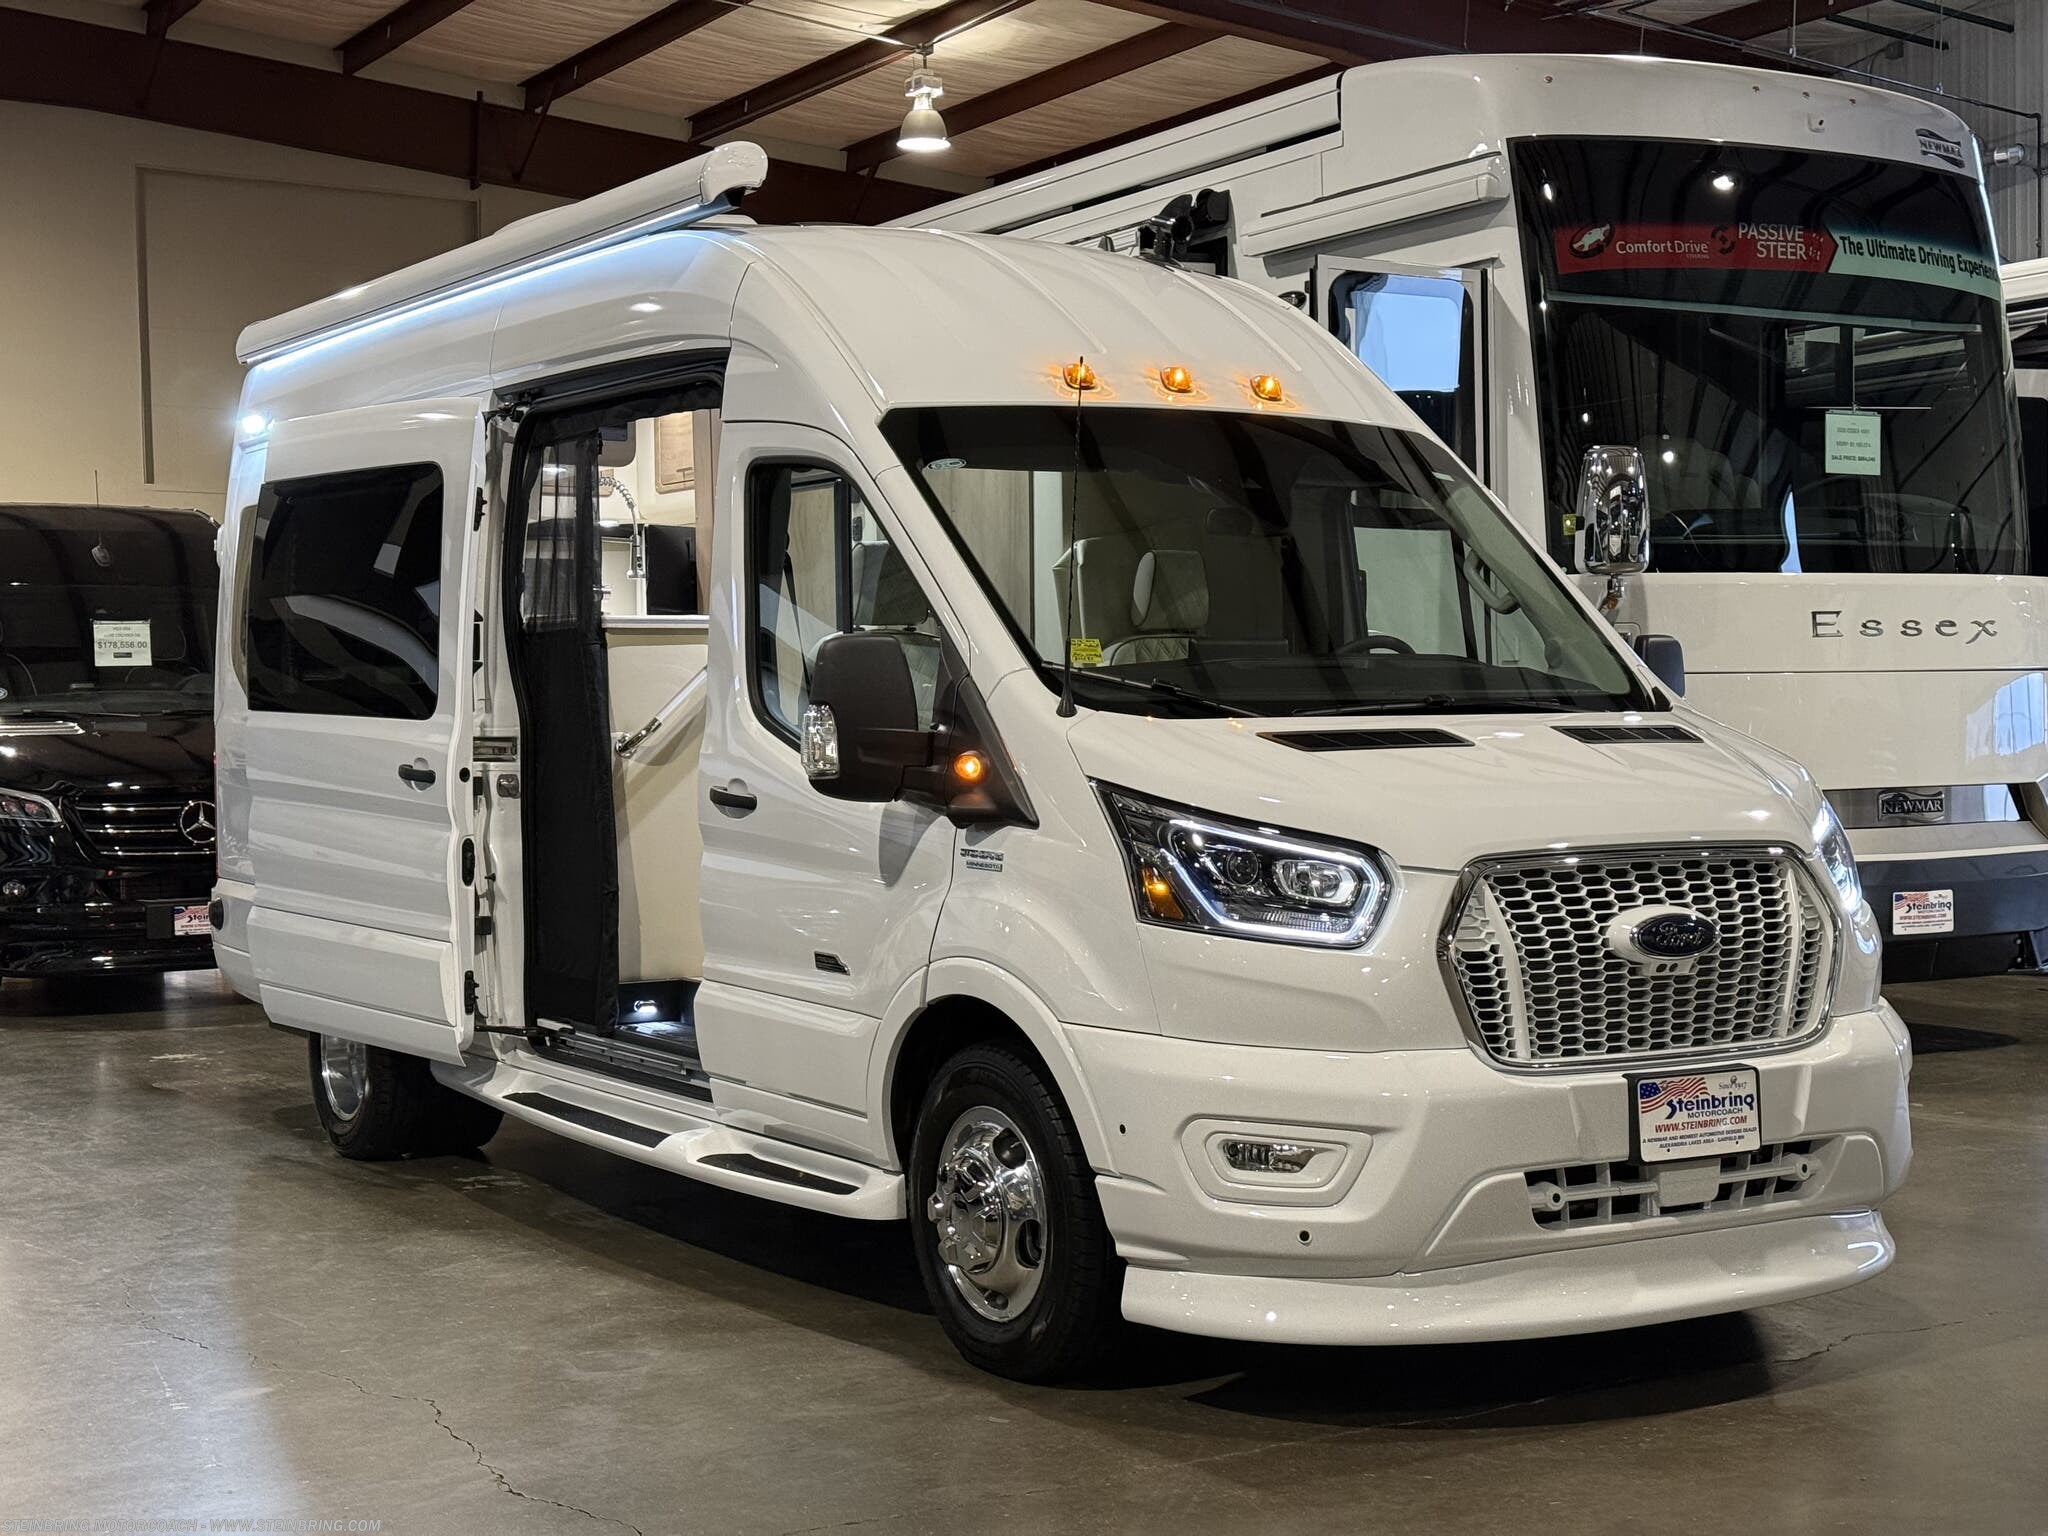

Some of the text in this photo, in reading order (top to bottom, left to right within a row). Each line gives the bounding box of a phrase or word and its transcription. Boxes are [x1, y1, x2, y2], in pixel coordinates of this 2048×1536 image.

[1738, 222, 1804, 242] PASSIVE
[1616, 239, 1709, 255] Comfort Drive
[1756, 240, 1808, 260] STEER
[1839, 236, 1864, 256] The
[1865, 238, 1916, 263] Ultimate
[1918, 246, 1956, 274] Driving
[1811, 610, 1998, 645] Essex
[1882, 799, 1943, 814] NEWMAR
[1905, 901, 1953, 914] Steinbring
[1665, 1091, 1755, 1120] Steinbring
[1687, 1107, 1743, 1119] MOTORCOACH
[1655, 1115, 1748, 1133] WWW.STEINBRING.COM
